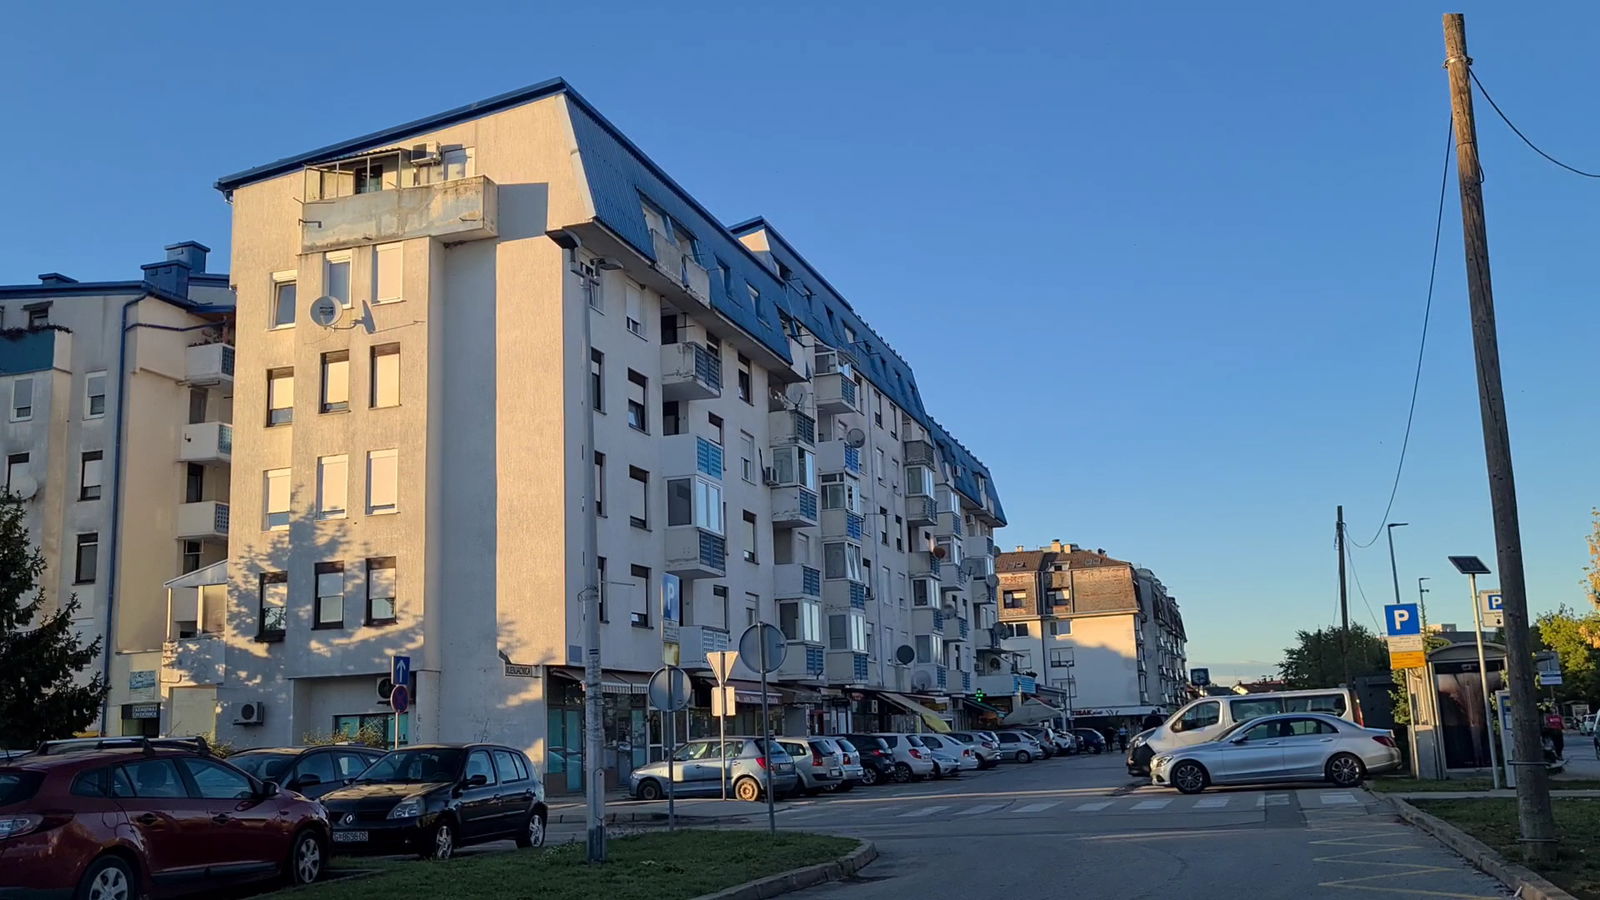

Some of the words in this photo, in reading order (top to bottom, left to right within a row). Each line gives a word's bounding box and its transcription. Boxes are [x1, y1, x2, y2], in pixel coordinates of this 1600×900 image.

[667, 582, 675, 610] P
[1491, 596, 1502, 609] P
[1393, 609, 1409, 630] P
